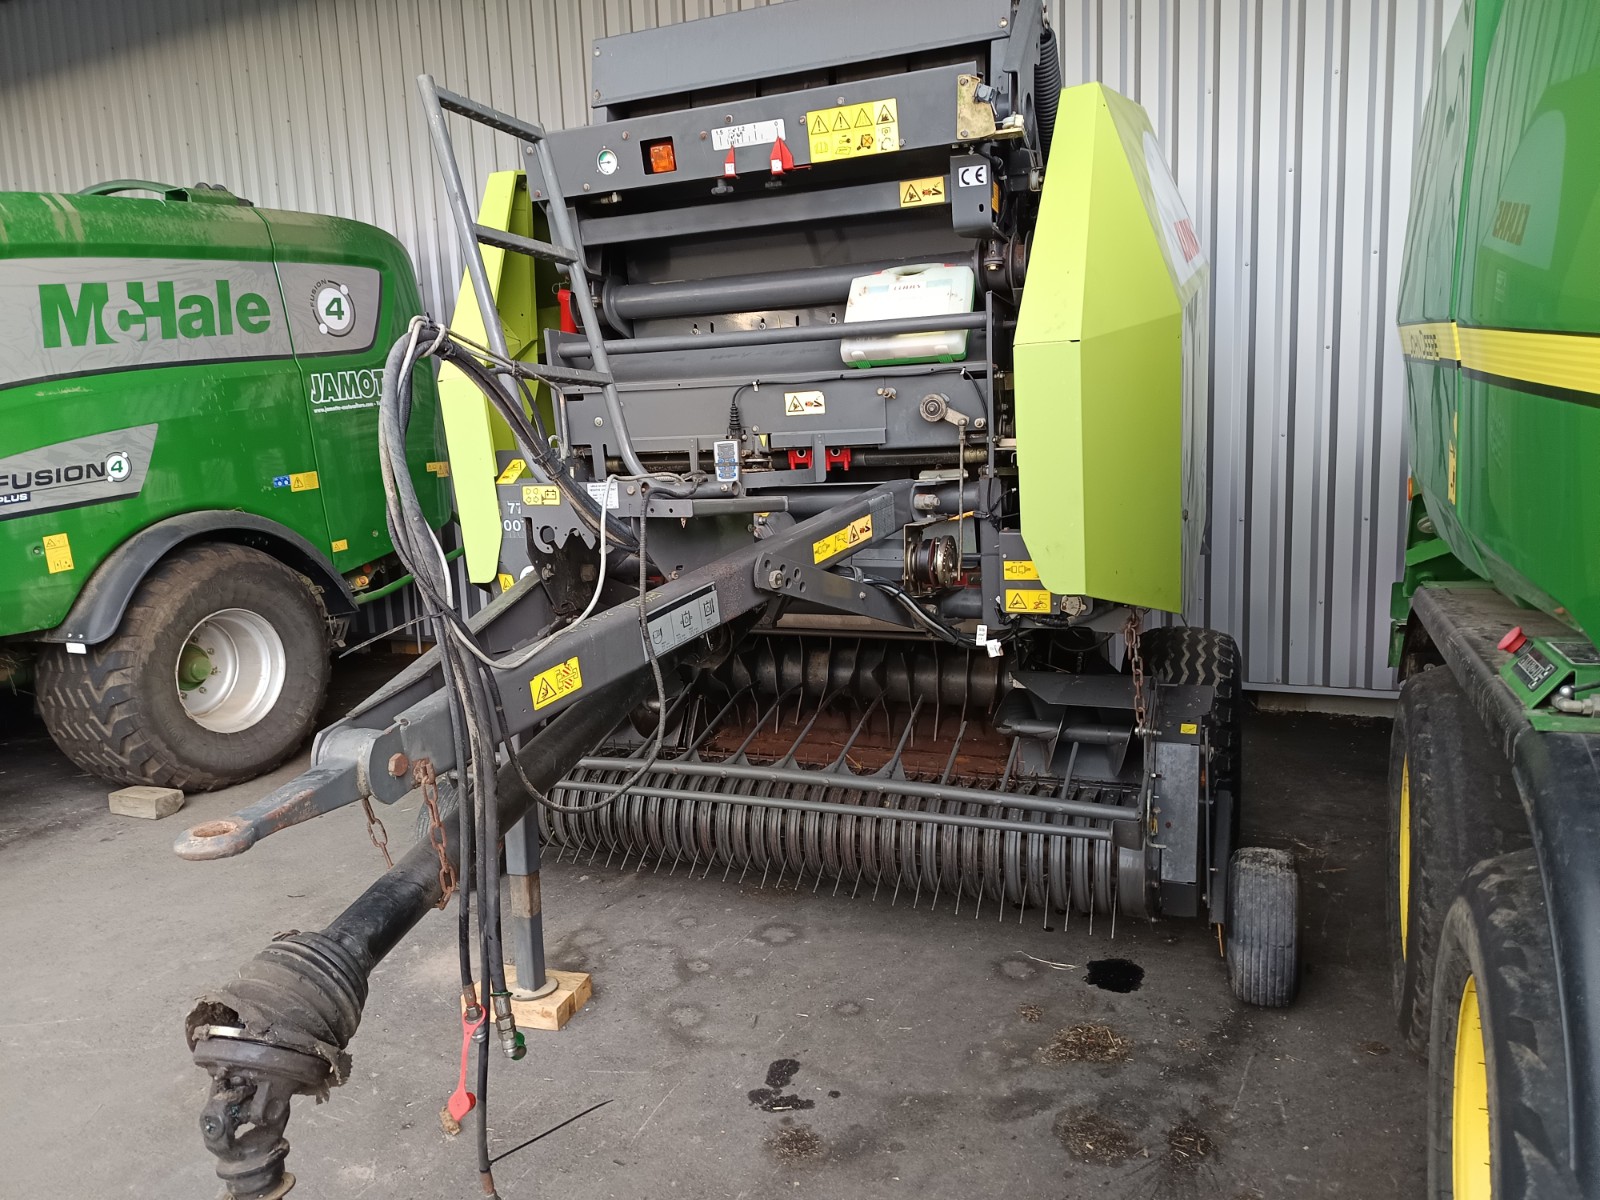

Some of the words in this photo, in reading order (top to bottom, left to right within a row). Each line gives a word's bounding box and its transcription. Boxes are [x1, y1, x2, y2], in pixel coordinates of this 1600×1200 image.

[961, 166, 984, 186] CE
[310, 278, 327, 308] FUSION
[38, 279, 271, 349] McHale
[325, 297, 345, 321] 4
[0, 461, 105, 490] FUSION
[110, 460, 124, 473] 4
